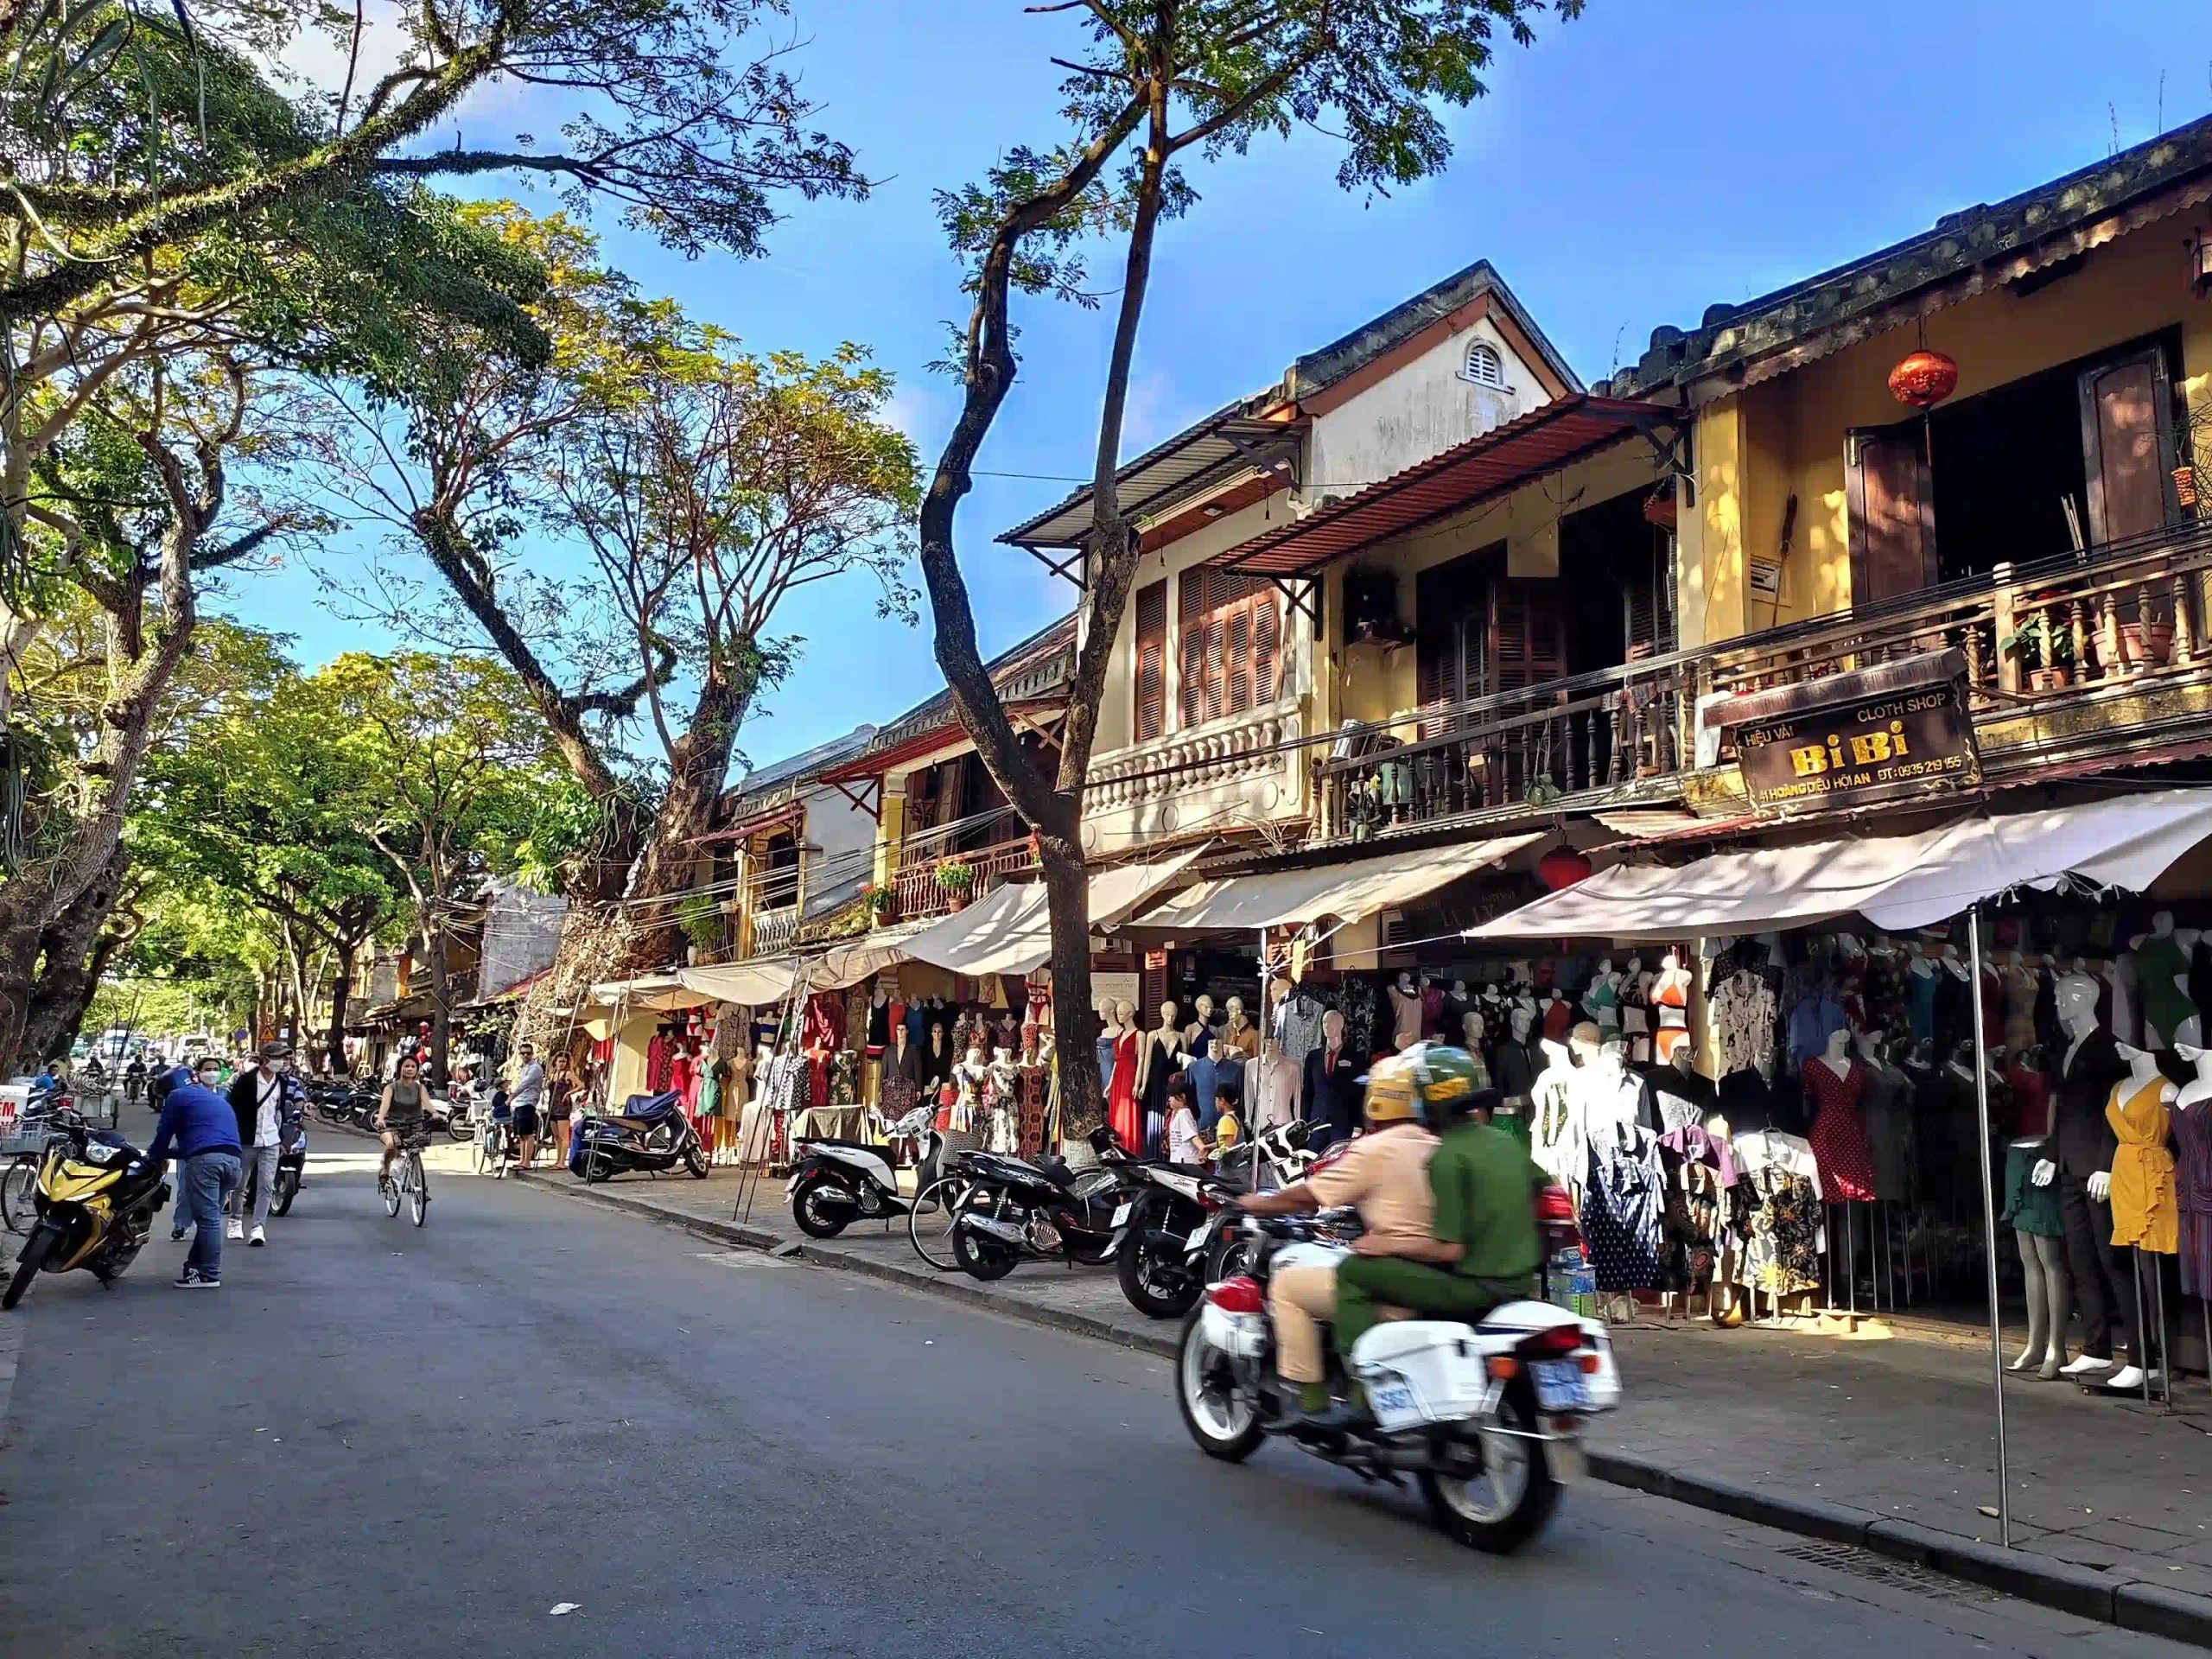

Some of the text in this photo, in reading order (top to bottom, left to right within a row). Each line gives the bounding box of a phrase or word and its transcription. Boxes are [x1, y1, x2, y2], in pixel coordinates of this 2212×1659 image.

[1858, 693, 1946, 722] CLOTH SHOP
[1745, 729, 1772, 747] HIỆU
[1789, 721, 1910, 778] Bi Bi
[1833, 773, 1853, 790] HỘI
[1853, 772, 1872, 786] AN
